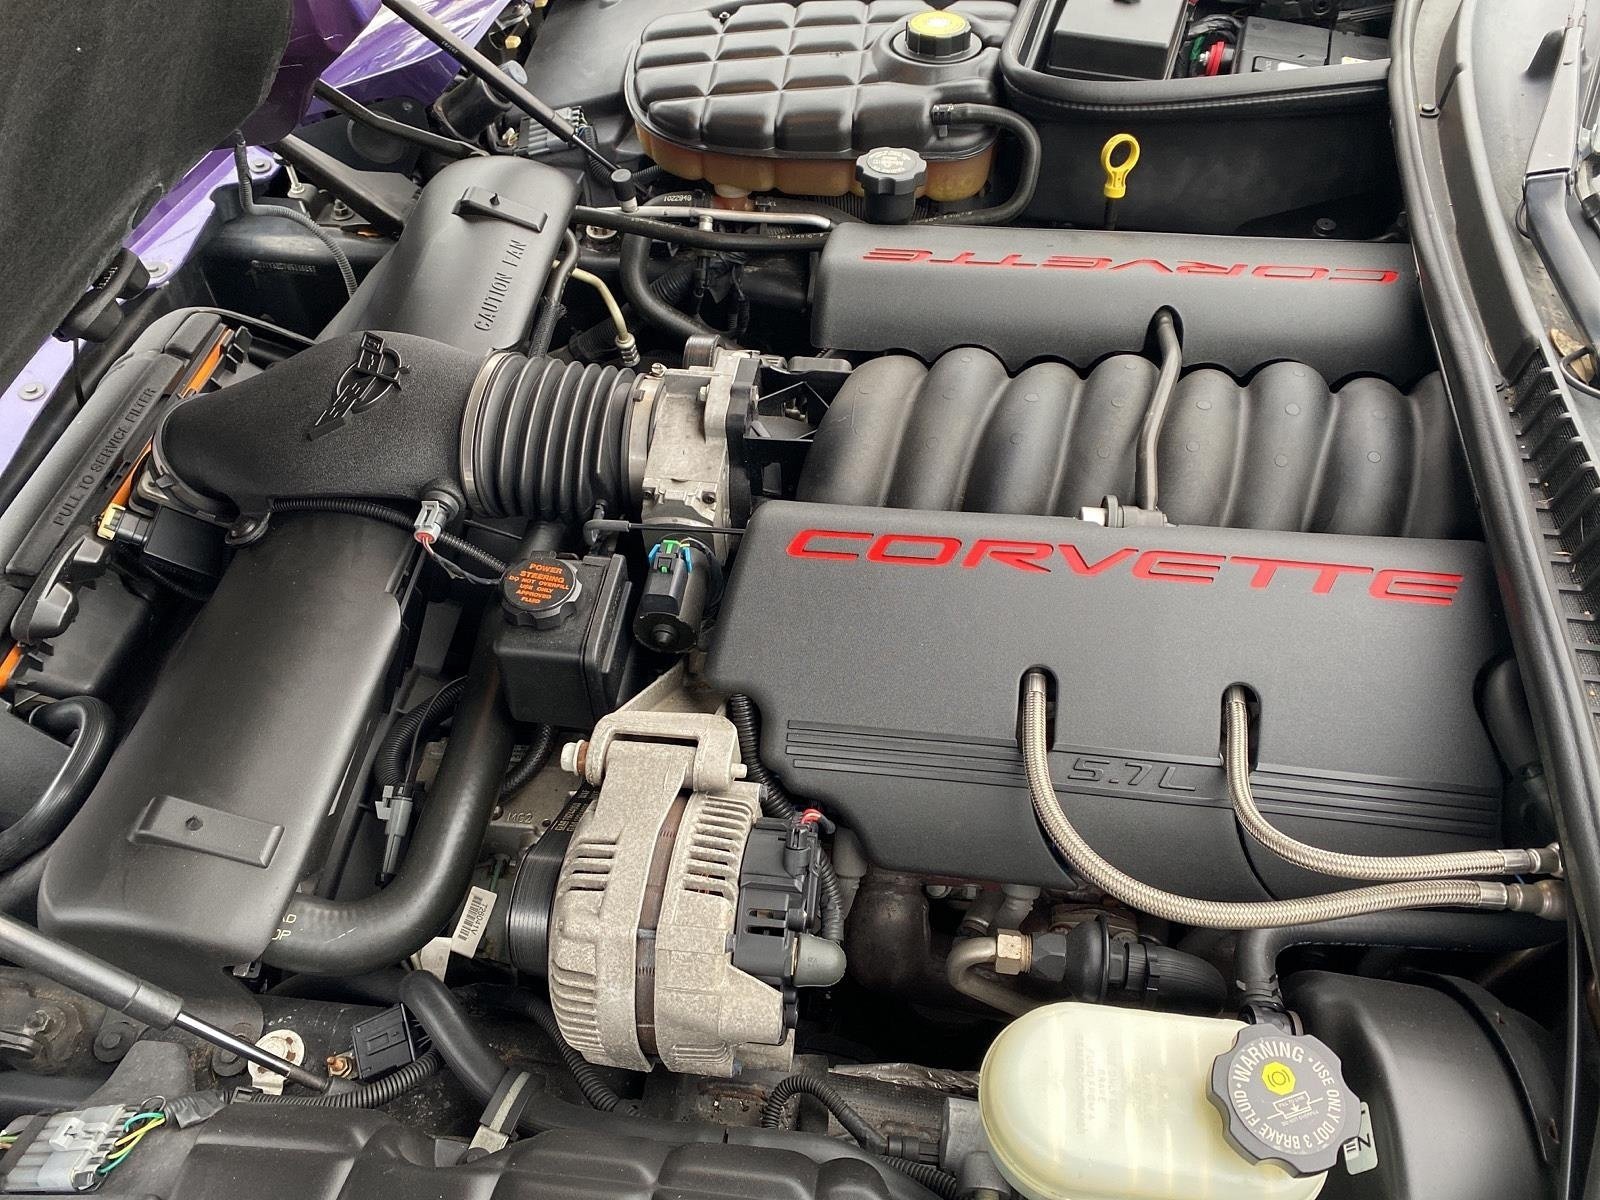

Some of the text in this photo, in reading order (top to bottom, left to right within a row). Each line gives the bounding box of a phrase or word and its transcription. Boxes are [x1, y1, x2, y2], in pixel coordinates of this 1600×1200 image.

[860, 248, 1400, 284] CORVETTE
[474, 272, 512, 331] CAUTION
[53, 387, 157, 526] PULL TO SERVICE FILTER
[520, 571, 565, 583] STEERING
[529, 563, 563, 574] POWER
[785, 529, 1465, 606] CORVETTE
[516, 589, 552, 600] APPROVED
[538, 581, 570, 590] OVERFILL
[1067, 758, 1196, 791] 5.7L
[282, 914, 297, 923] D
[1233, 1040, 1305, 1083] WARNING
[1312, 1061, 1334, 1087] USE
[1233, 1090, 1260, 1127] FLUID
[1326, 1089, 1341, 1124] ONLY
[1259, 1123, 1300, 1149] BRAKE
[1303, 1134, 1313, 1148] 3
[1316, 1121, 1335, 1145] DOT
